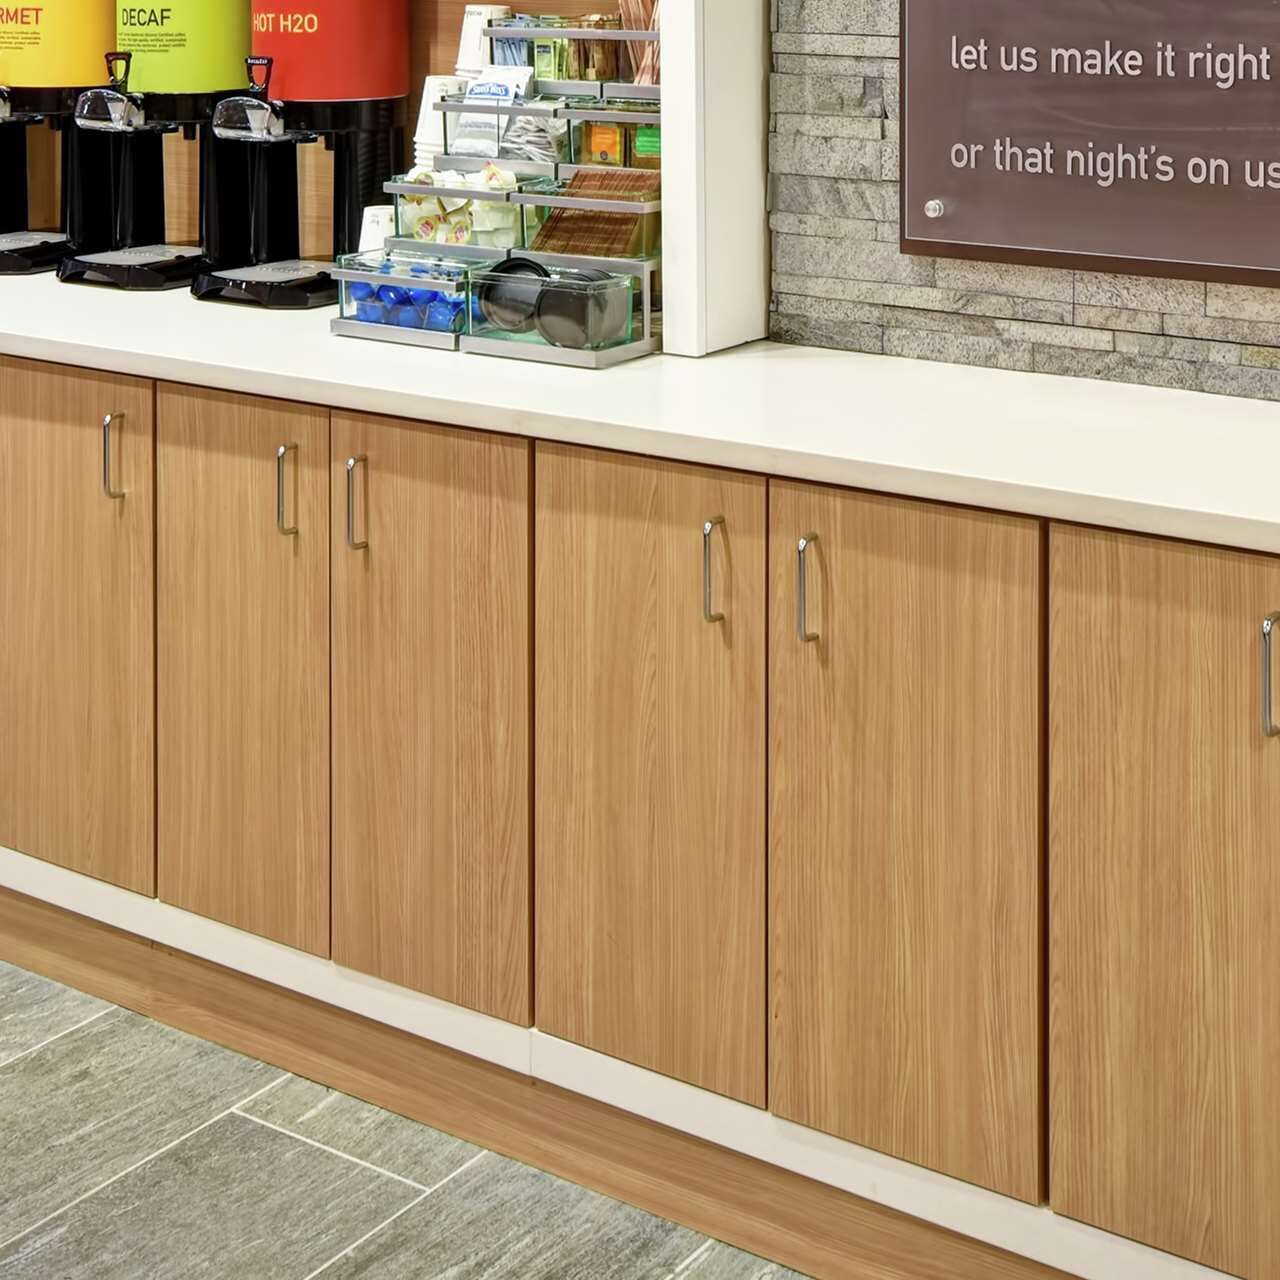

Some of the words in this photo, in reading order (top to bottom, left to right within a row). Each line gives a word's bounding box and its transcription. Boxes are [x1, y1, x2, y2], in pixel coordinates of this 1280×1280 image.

[121, 8, 172, 27] DECAF
[253, 13, 276, 33] HOT
[279, 13, 319, 33] H2O
[951, 36, 988, 71] let
[1000, 44, 1038, 72] us
[1050, 40, 1143, 77] make
[1155, 42, 1176, 78] it
[1187, 43, 1271, 89] right
[950, 142, 984, 169] or
[993, 137, 1054, 175] that
[1066, 141, 1174, 188] night's
[1186, 155, 1230, 185] on
